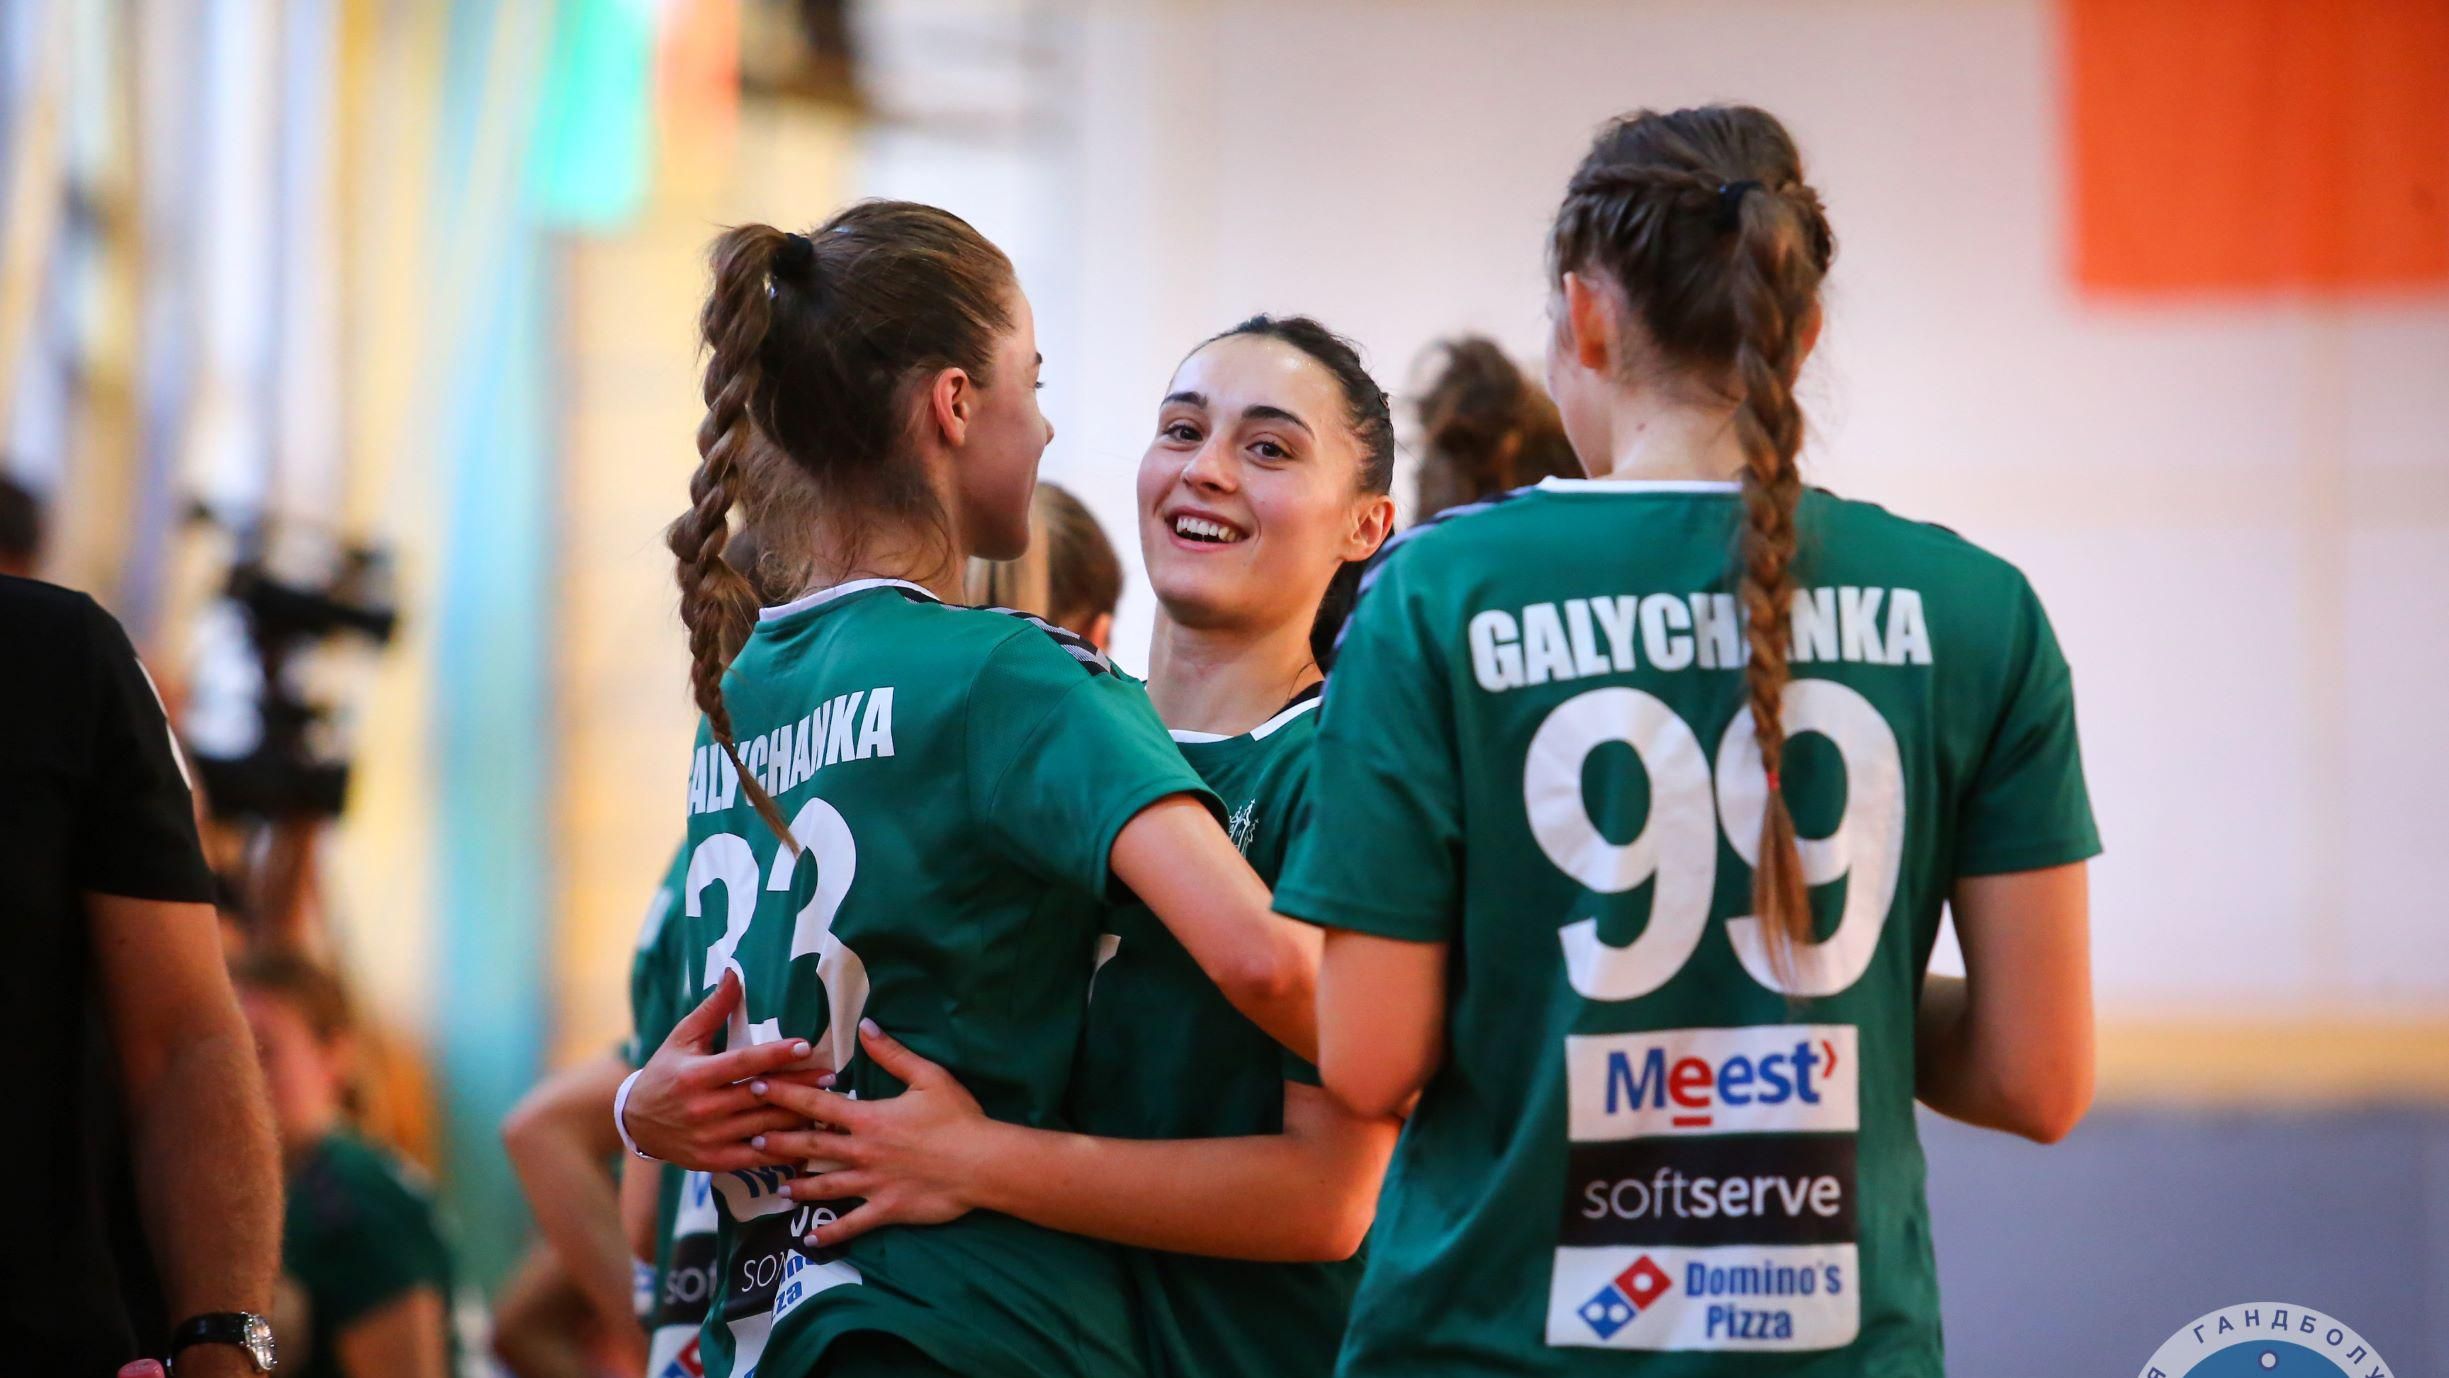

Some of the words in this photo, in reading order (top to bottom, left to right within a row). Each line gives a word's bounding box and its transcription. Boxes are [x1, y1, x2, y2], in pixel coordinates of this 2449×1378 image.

[1468, 586, 1933, 692] GALYCHNKA
[688, 686, 895, 816] ALYCHANKA
[1524, 679, 1906, 1000] 99
[1605, 1041, 1821, 1122] Meest
[1582, 1167, 1842, 1219] softserve
[1685, 1260, 1842, 1297] Domino's
[1706, 1305, 1793, 1340] Pizza
